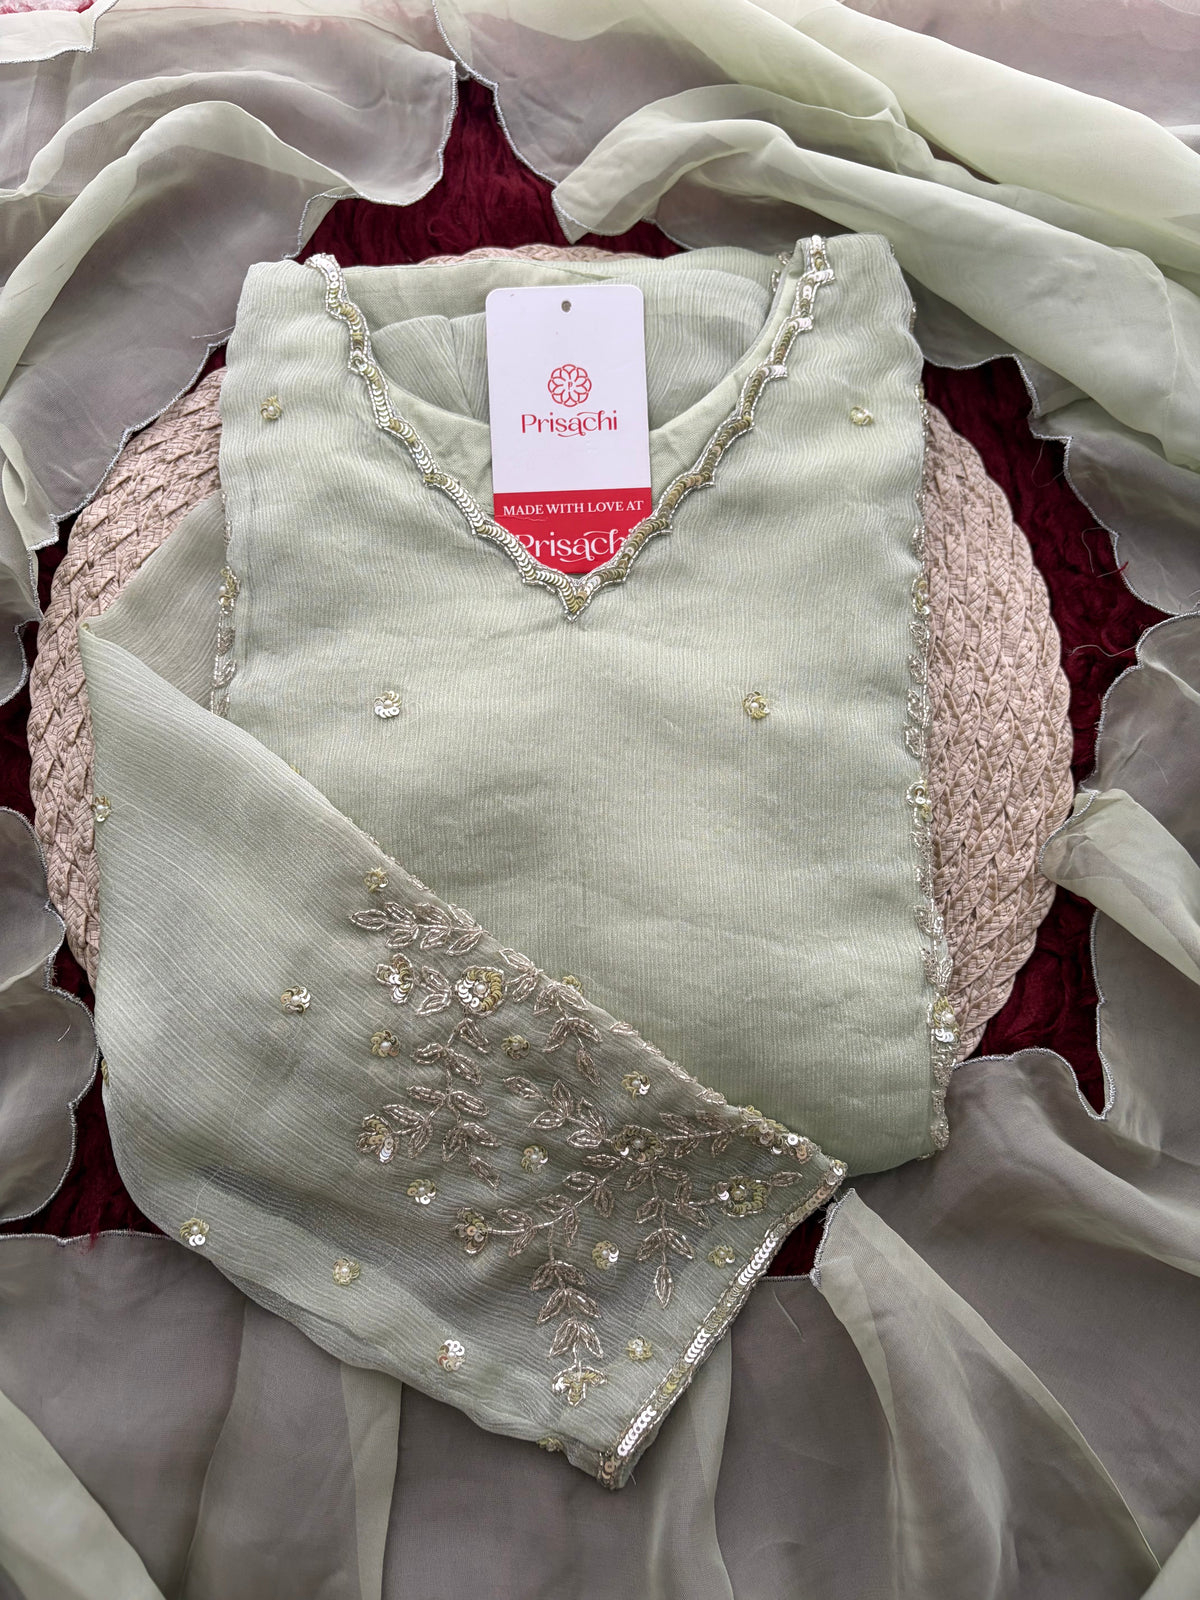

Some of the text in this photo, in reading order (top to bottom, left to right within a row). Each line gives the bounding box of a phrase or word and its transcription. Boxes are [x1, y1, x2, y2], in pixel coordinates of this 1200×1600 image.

[521, 410, 618, 438] Prisachi
[503, 500, 644, 516] MADE WITH LOVE AT
[515, 528, 633, 563] Prisach
